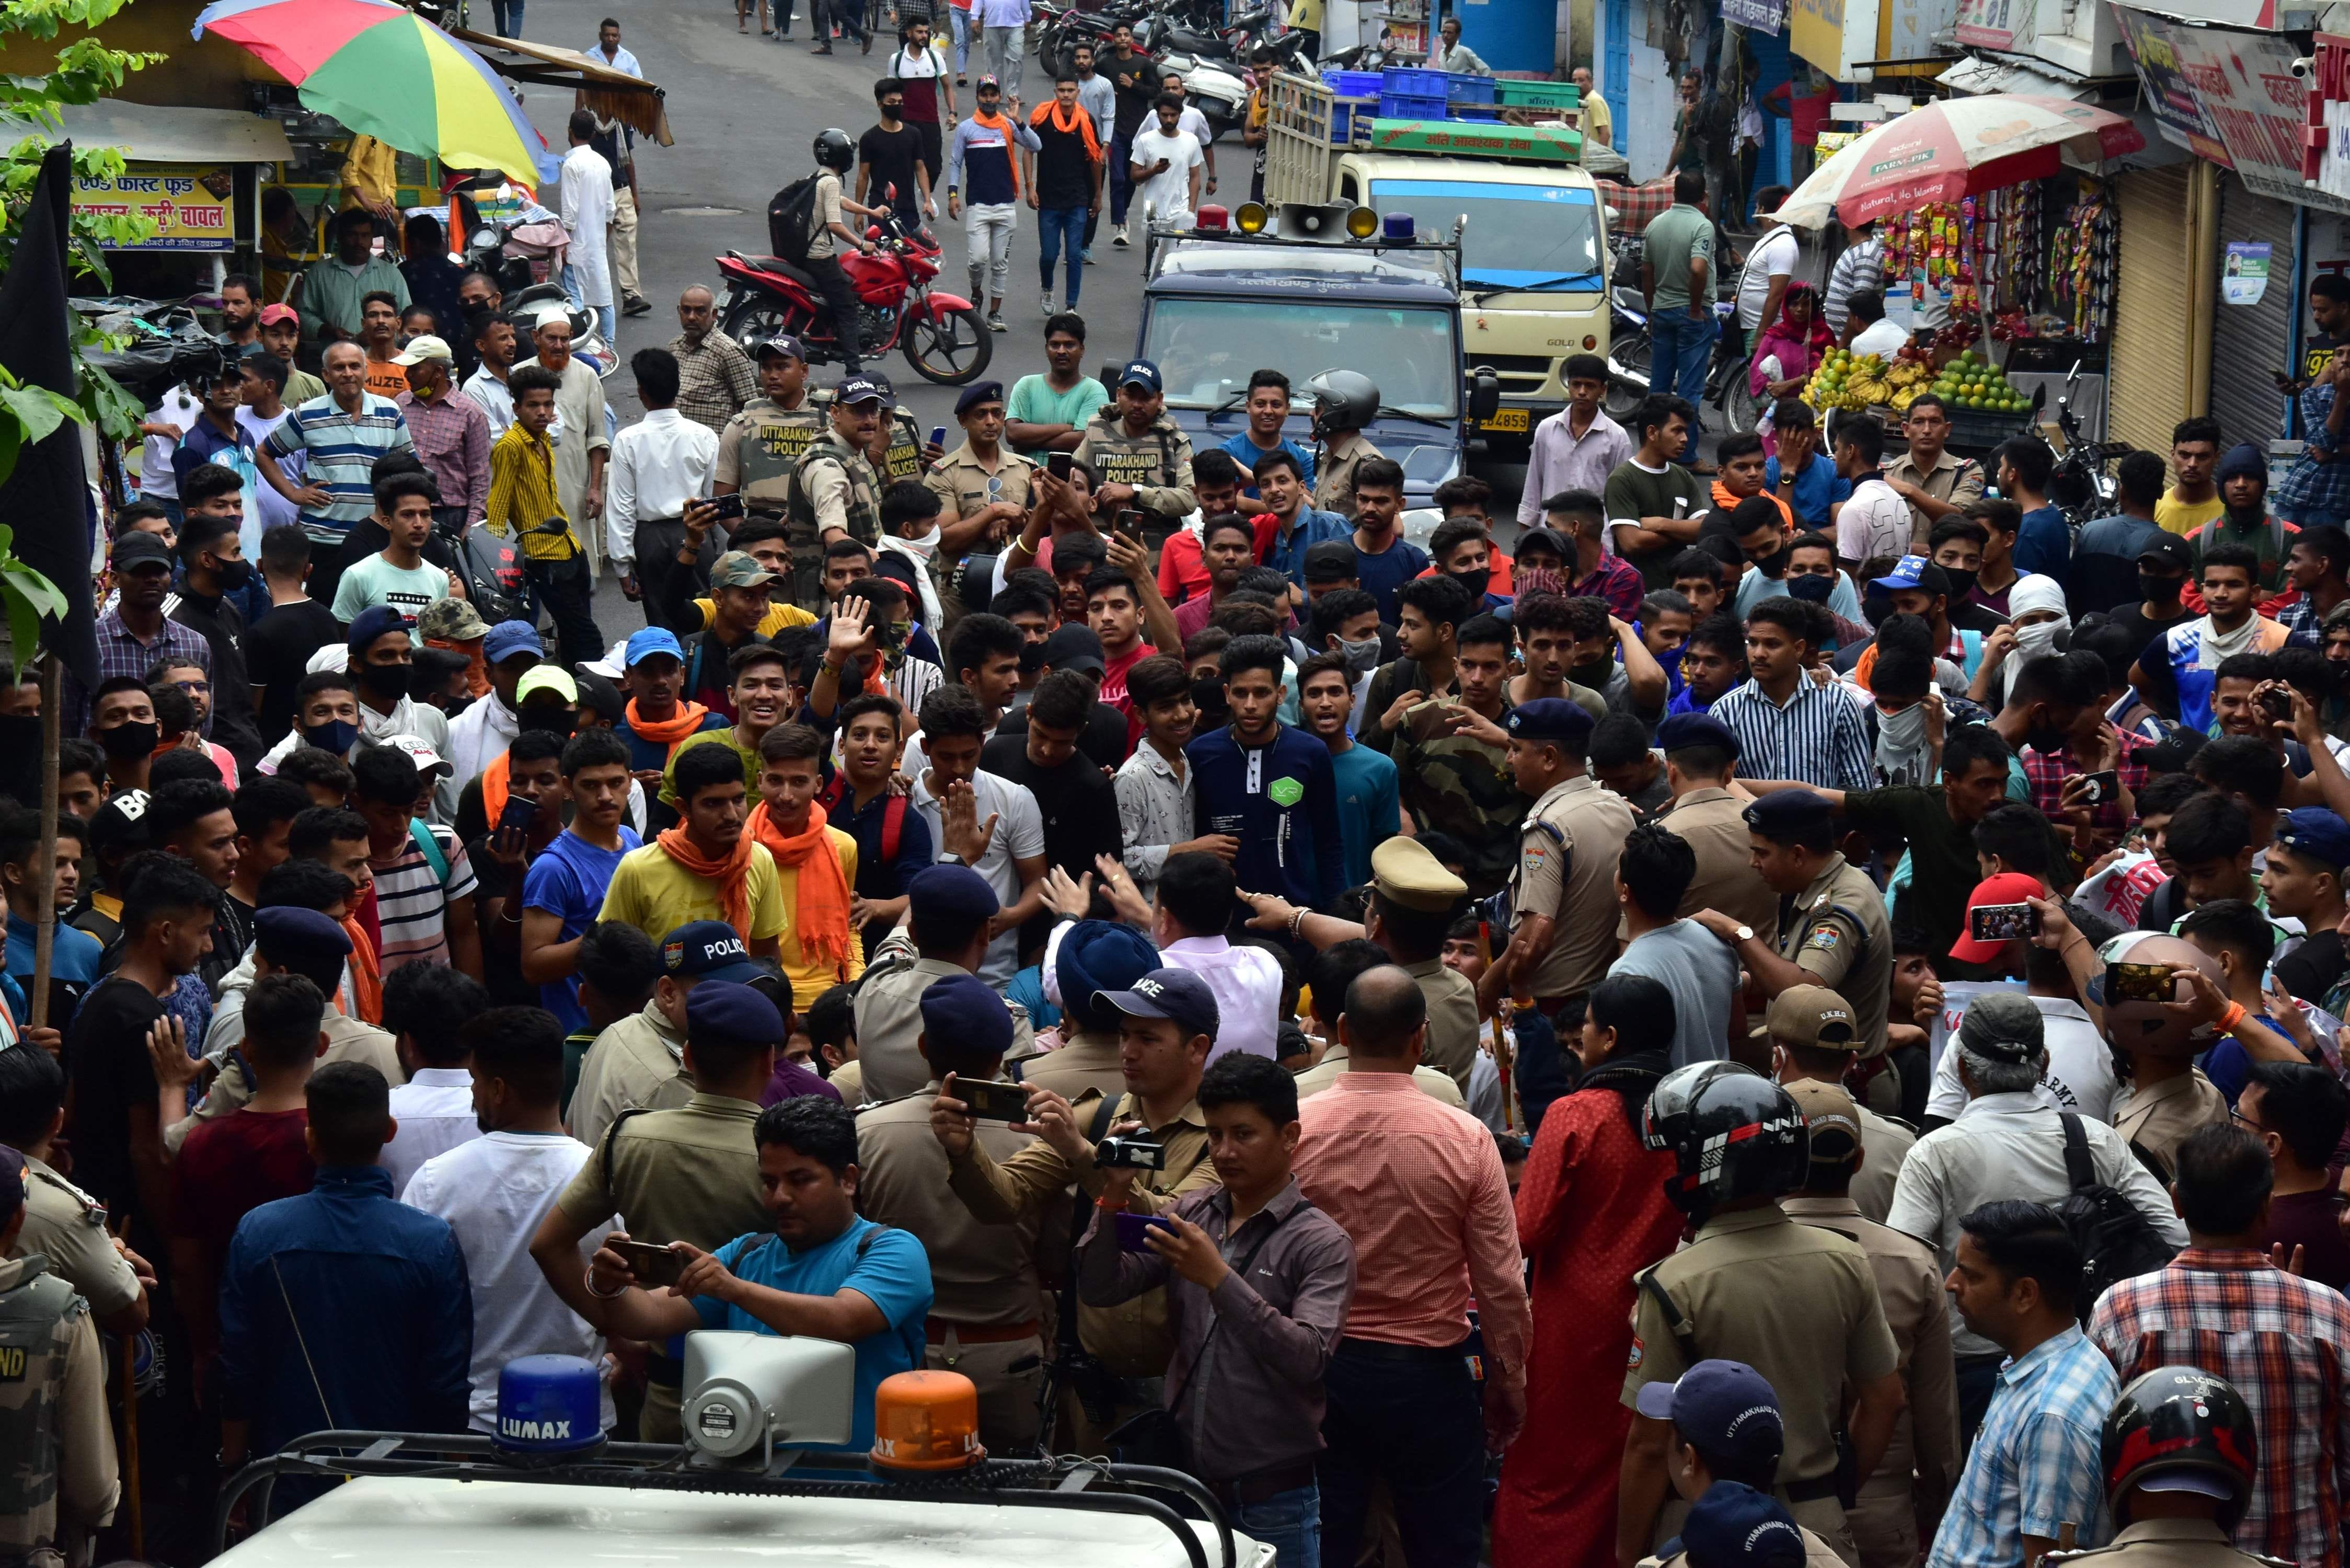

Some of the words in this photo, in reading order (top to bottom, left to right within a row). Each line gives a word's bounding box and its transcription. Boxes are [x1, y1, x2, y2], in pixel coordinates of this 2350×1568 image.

[1425, 132, 1449, 146] अति
[1453, 136, 1503, 149] आवश्यक
[1508, 138, 1531, 151] सेवा
[116, 177, 160, 192] फास्ट
[164, 177, 194, 196] फूड
[1861, 192, 1897, 212] Natural,
[1899, 190, 1911, 200] No
[179, 205, 225, 227] चावल
[1547, 339, 1574, 348] GOLD
[1131, 365, 1153, 378] POLICE
[762, 425, 815, 441] UTTARAKHA
[774, 441, 810, 456] POLIC
[889, 459, 916, 477] OLICE
[1096, 454, 1157, 468] UTTARAKHAND
[1106, 469, 1145, 483] POLICE
[704, 938, 747, 961] POLIC
[502, 1416, 571, 1440] LUMAX
[1726, 1405, 1773, 1438] UTTARAKHAND
[1744, 1520, 1784, 1552] UTTARAKHAND
